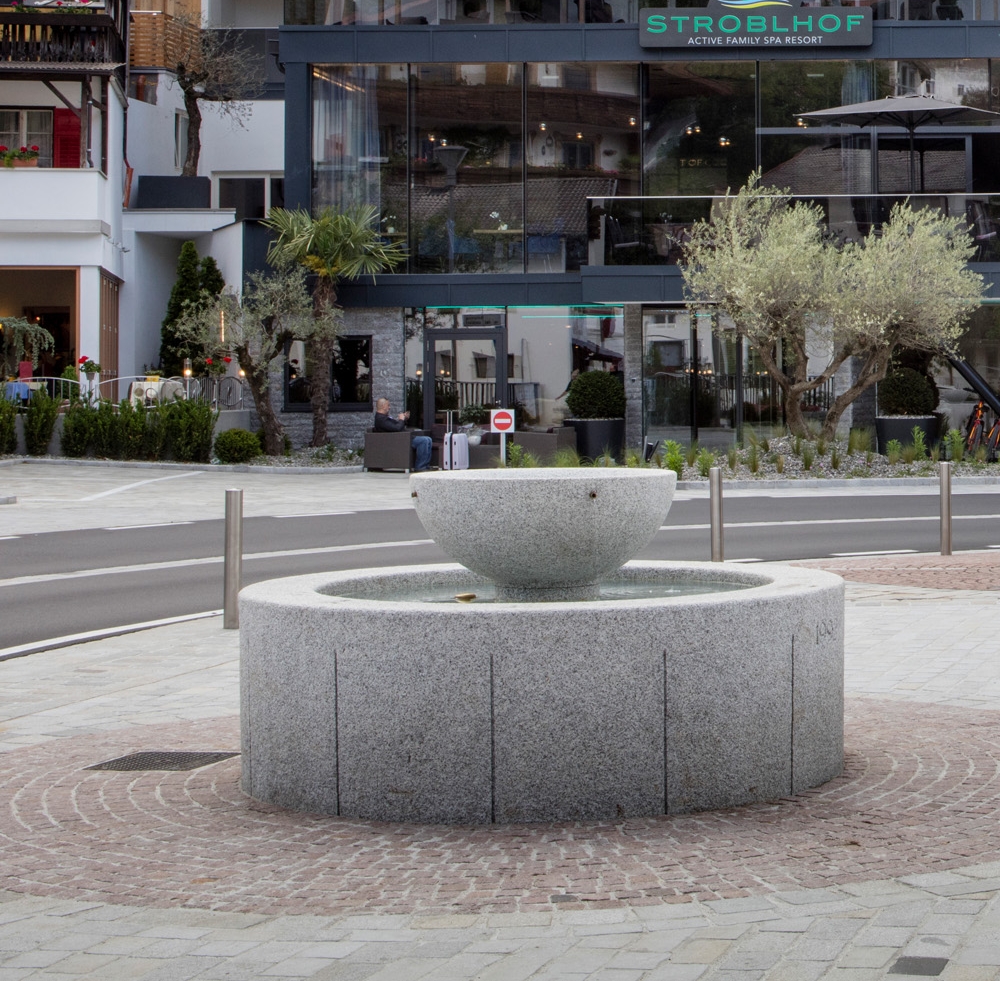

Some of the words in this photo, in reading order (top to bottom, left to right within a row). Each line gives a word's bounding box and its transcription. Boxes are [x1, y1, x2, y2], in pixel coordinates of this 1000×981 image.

[646, 13, 865, 34] STROBLHOF
[687, 36, 723, 45] ACTIVE
[726, 36, 761, 45] FAMILY
[763, 36, 782, 45] SPA
[785, 35, 823, 45] RESORT
